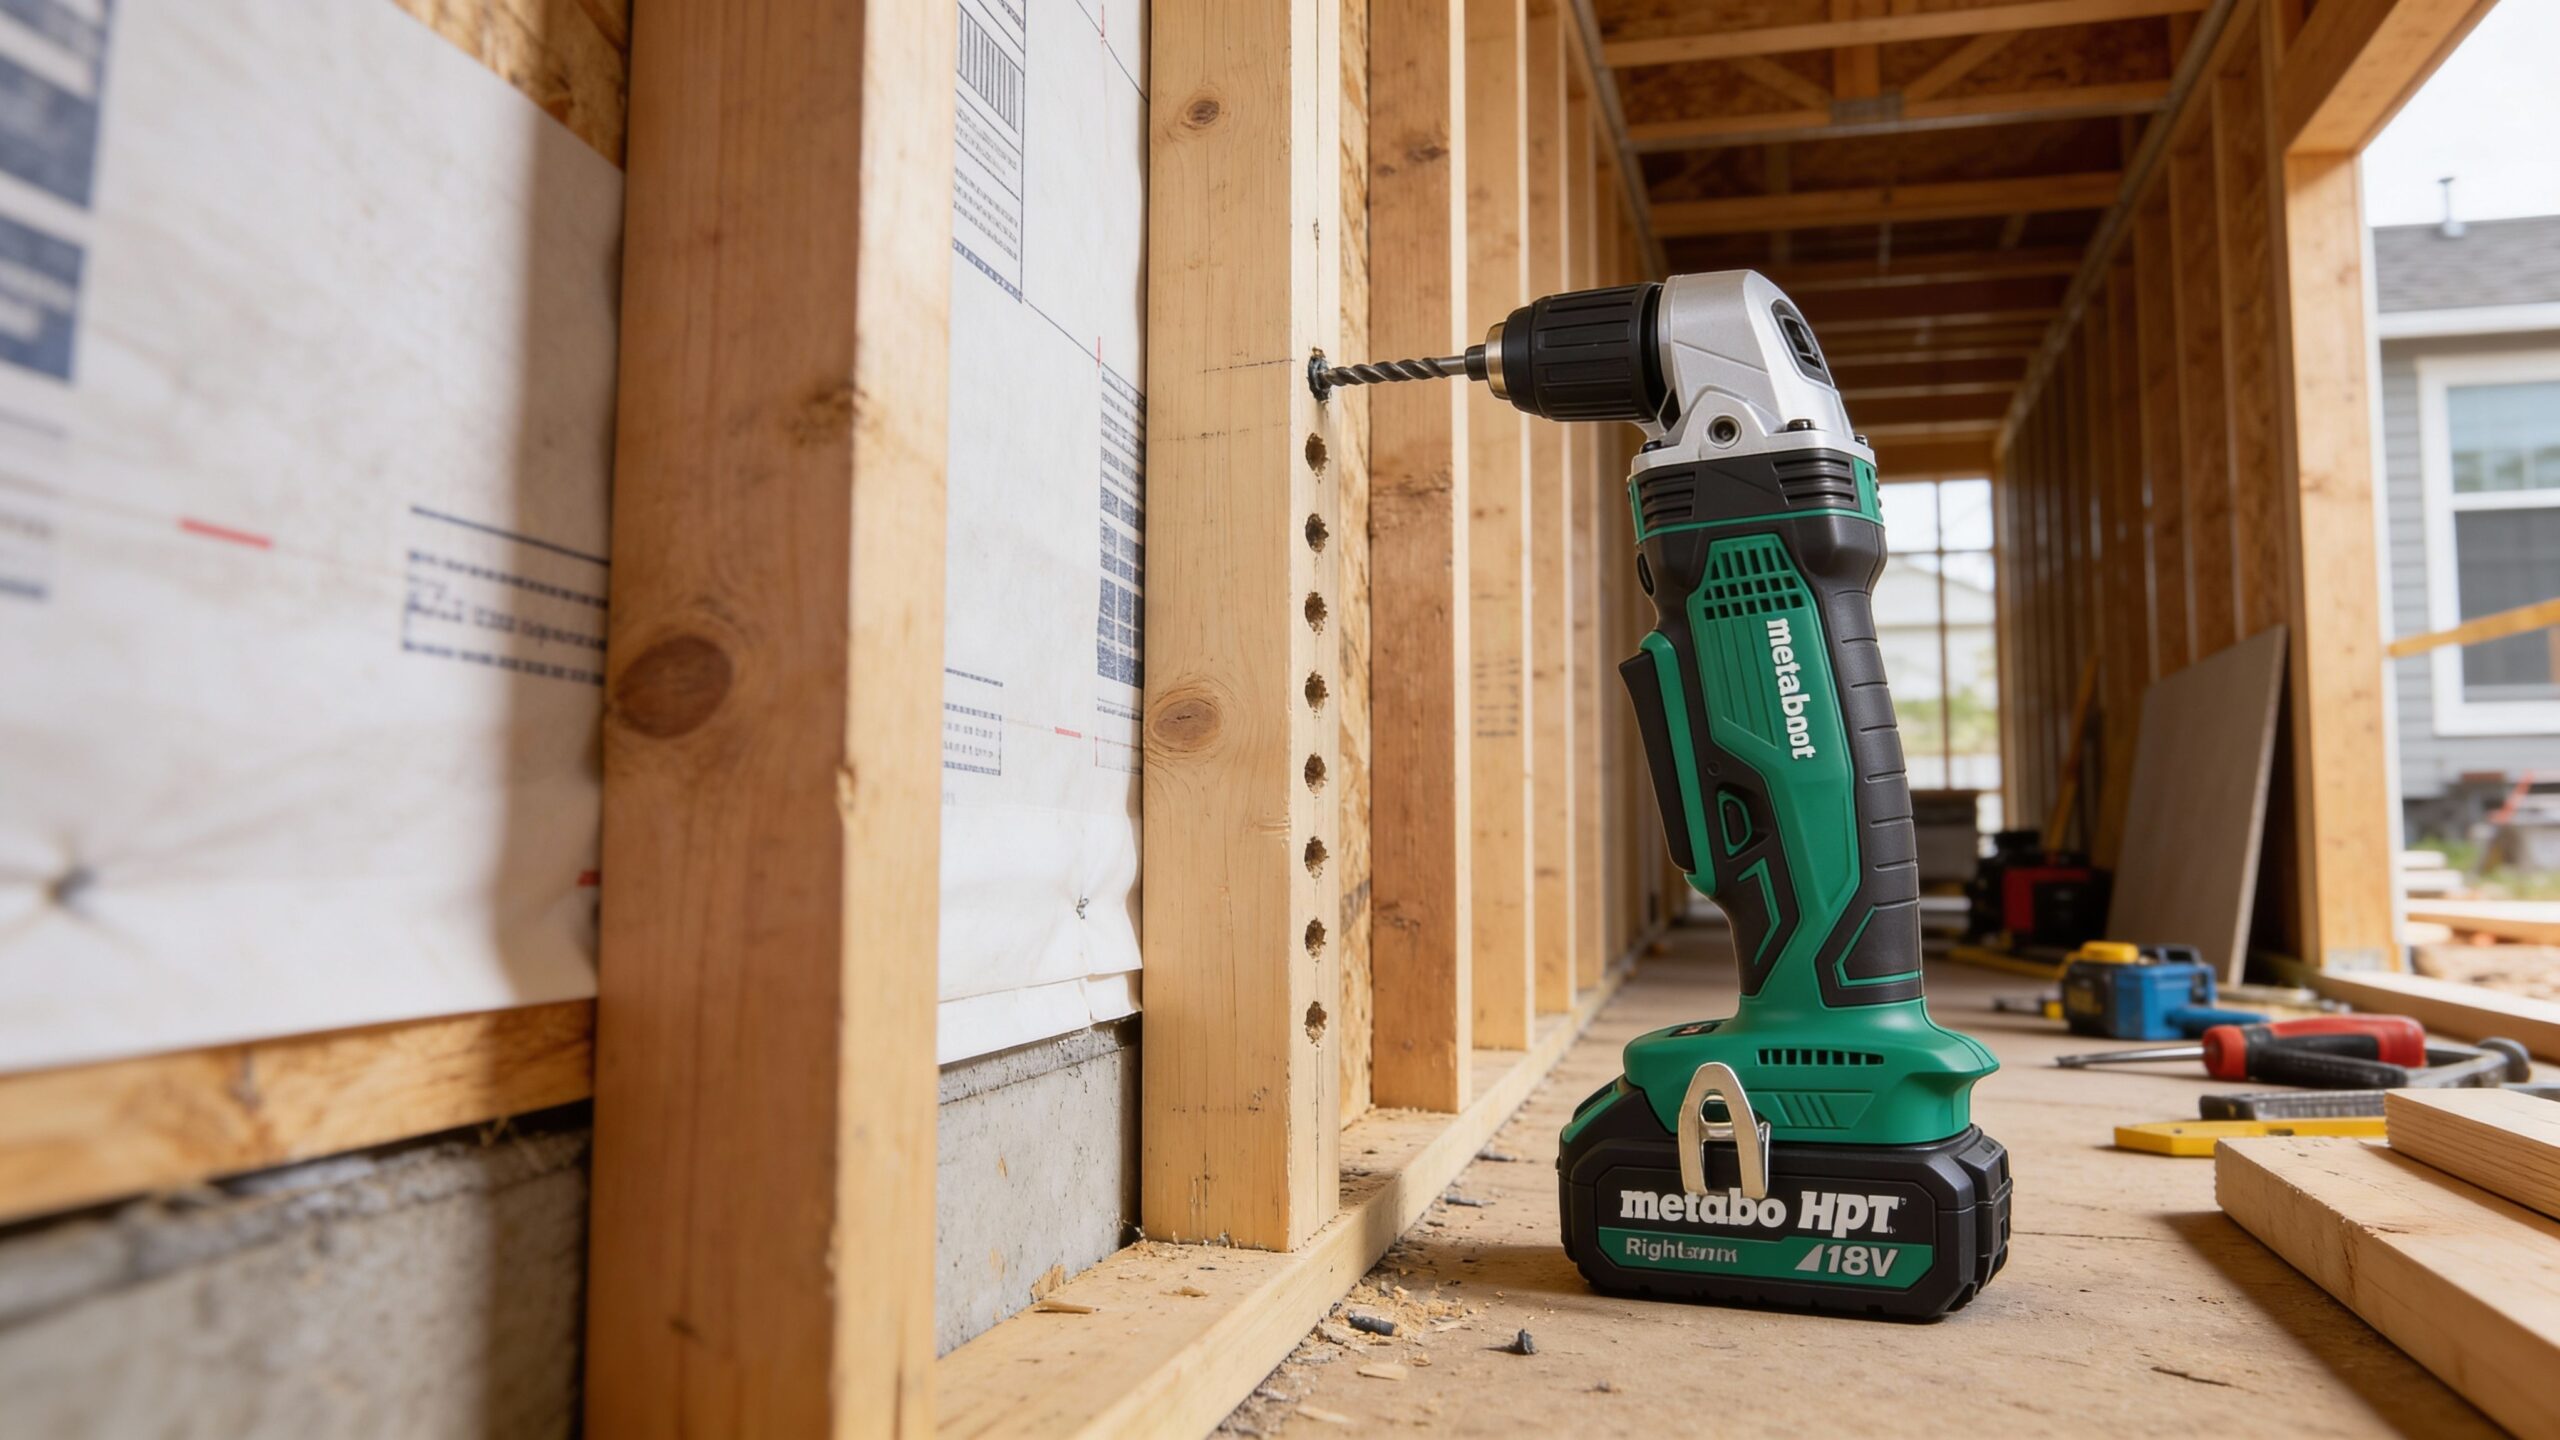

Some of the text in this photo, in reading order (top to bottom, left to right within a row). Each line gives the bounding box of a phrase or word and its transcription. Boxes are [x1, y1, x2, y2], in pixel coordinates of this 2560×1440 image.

[1620, 1187, 1900, 1239] metabo HPT
[1827, 1245, 1899, 1278] 18V
